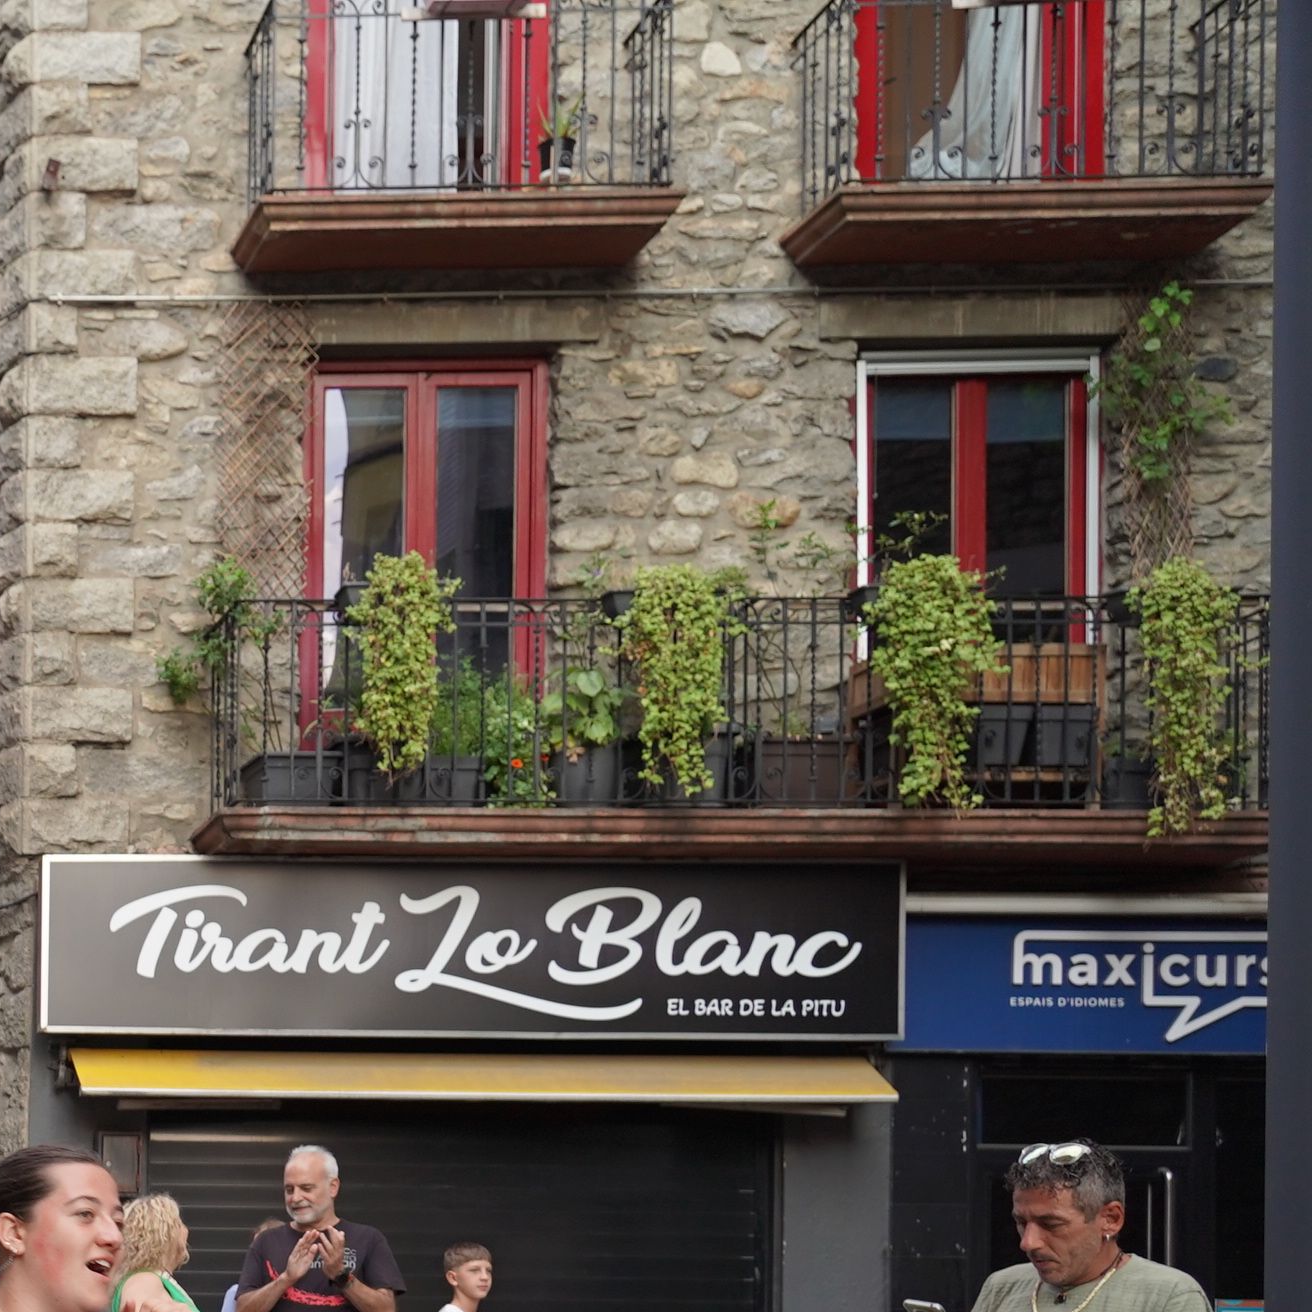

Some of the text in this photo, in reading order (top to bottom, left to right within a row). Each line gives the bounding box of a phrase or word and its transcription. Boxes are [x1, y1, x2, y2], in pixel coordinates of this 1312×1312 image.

[109, 884, 391, 978] Tirant
[545, 886, 863, 986] Blanc
[667, 998, 846, 1018] EL BAR DE LA PITU
[1009, 996, 1126, 1008] ESPAIS D'IDIOMES
